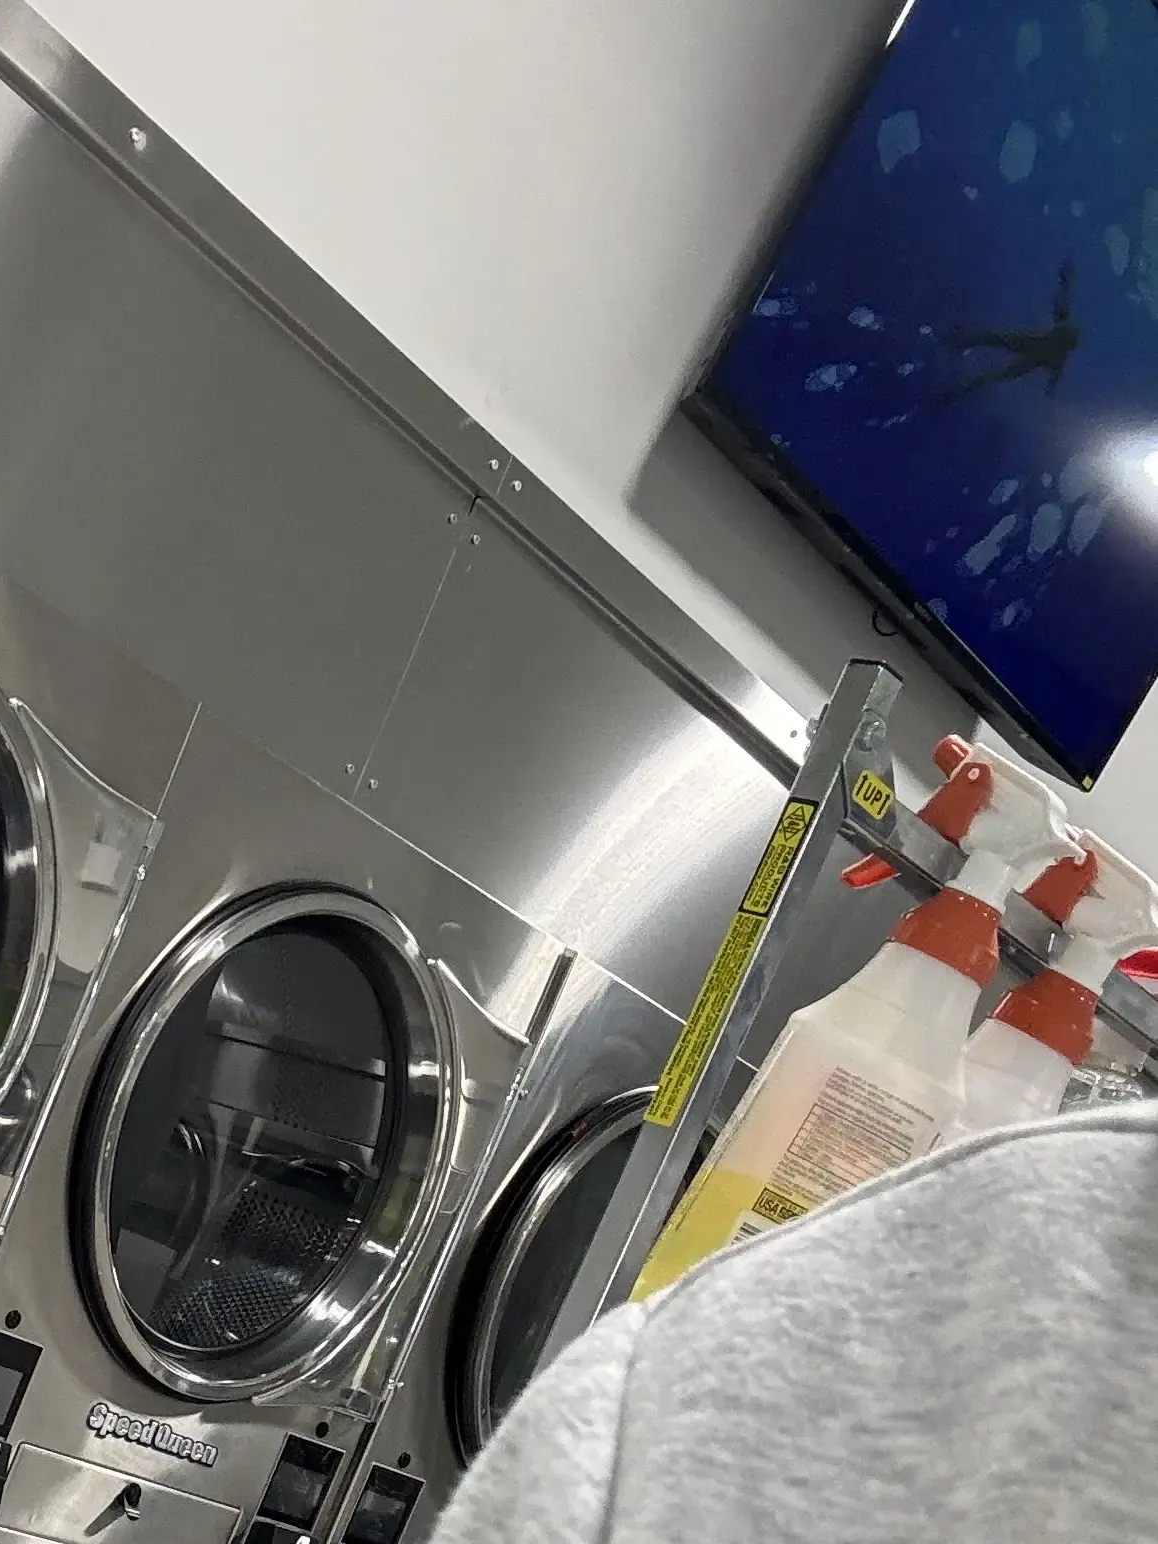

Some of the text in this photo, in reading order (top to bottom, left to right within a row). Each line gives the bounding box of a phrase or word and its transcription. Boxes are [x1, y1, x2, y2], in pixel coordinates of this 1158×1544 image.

[862, 782, 883, 806] UP
[757, 1195, 779, 1215] USA
[86, 1402, 218, 1467] Speed Queen
